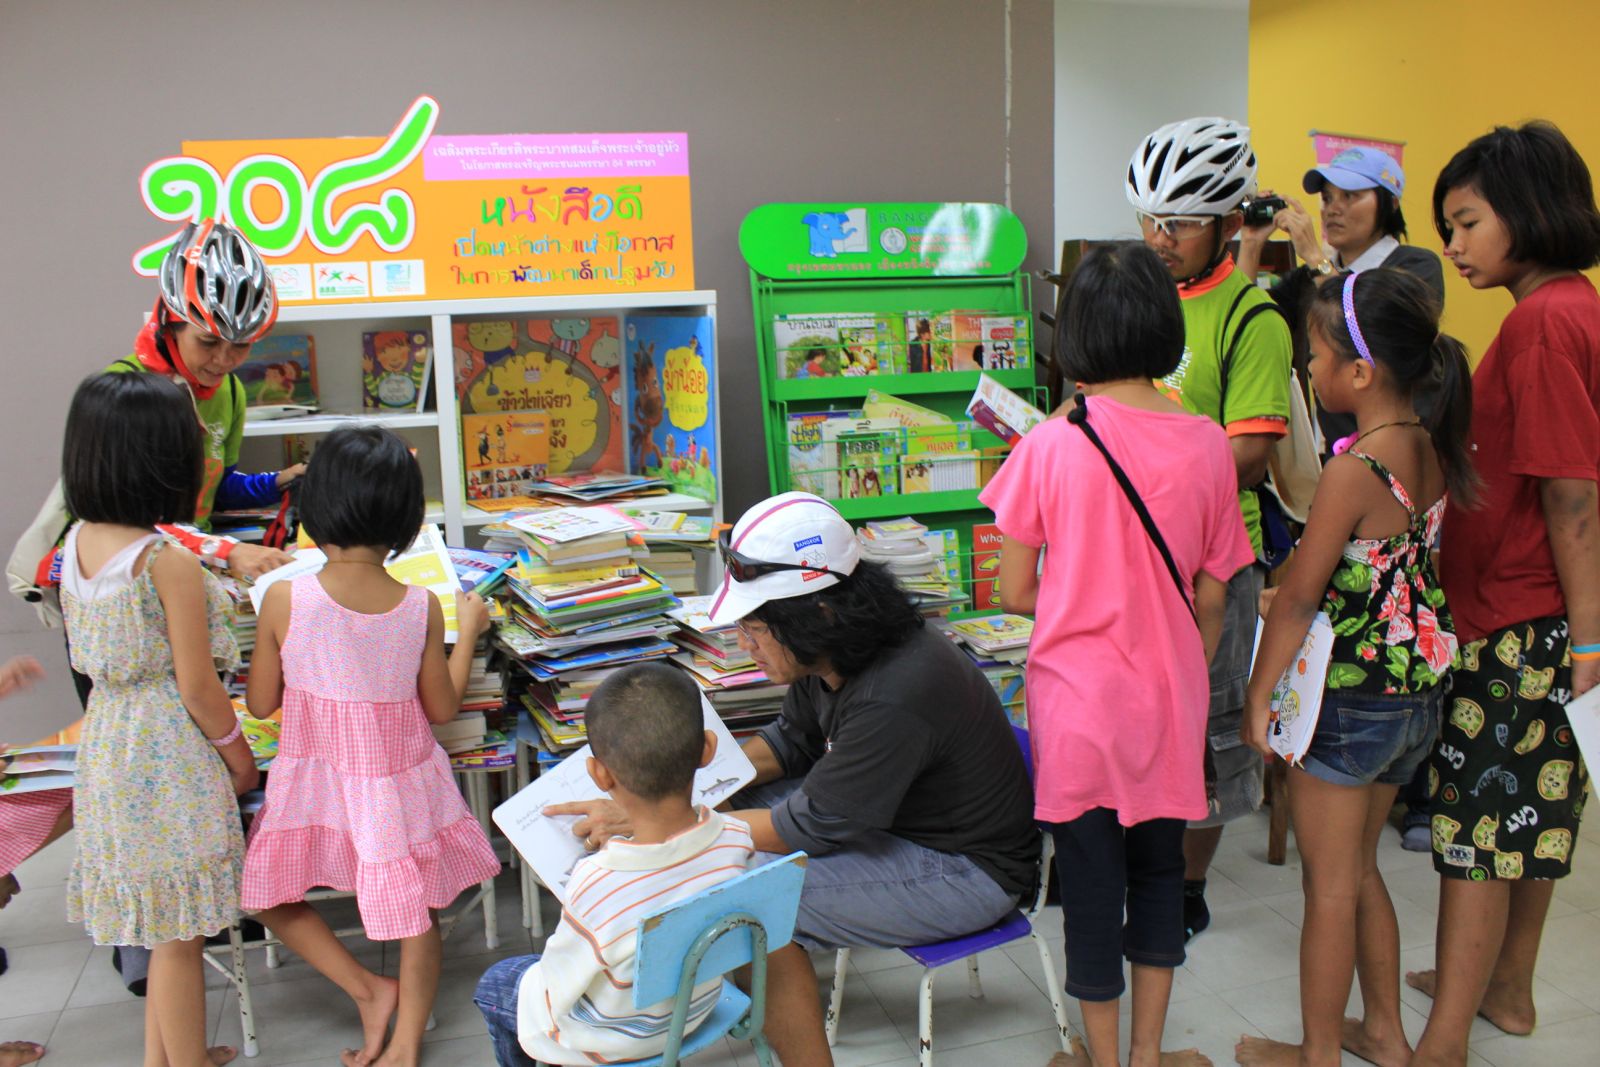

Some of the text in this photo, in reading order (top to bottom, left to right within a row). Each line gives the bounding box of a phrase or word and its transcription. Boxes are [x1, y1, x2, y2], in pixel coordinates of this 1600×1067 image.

[481, 184, 643, 226] หนังสือดี
[453, 228, 675, 257] เปิดหน้าต่างแห่งโอกาส
[450, 255, 675, 286] ในการพัฒนาเด็กปฐมวัย
[1548, 688, 1573, 705] AT
[1439, 742, 1466, 772] CAT
[1505, 805, 1538, 834] CAT
